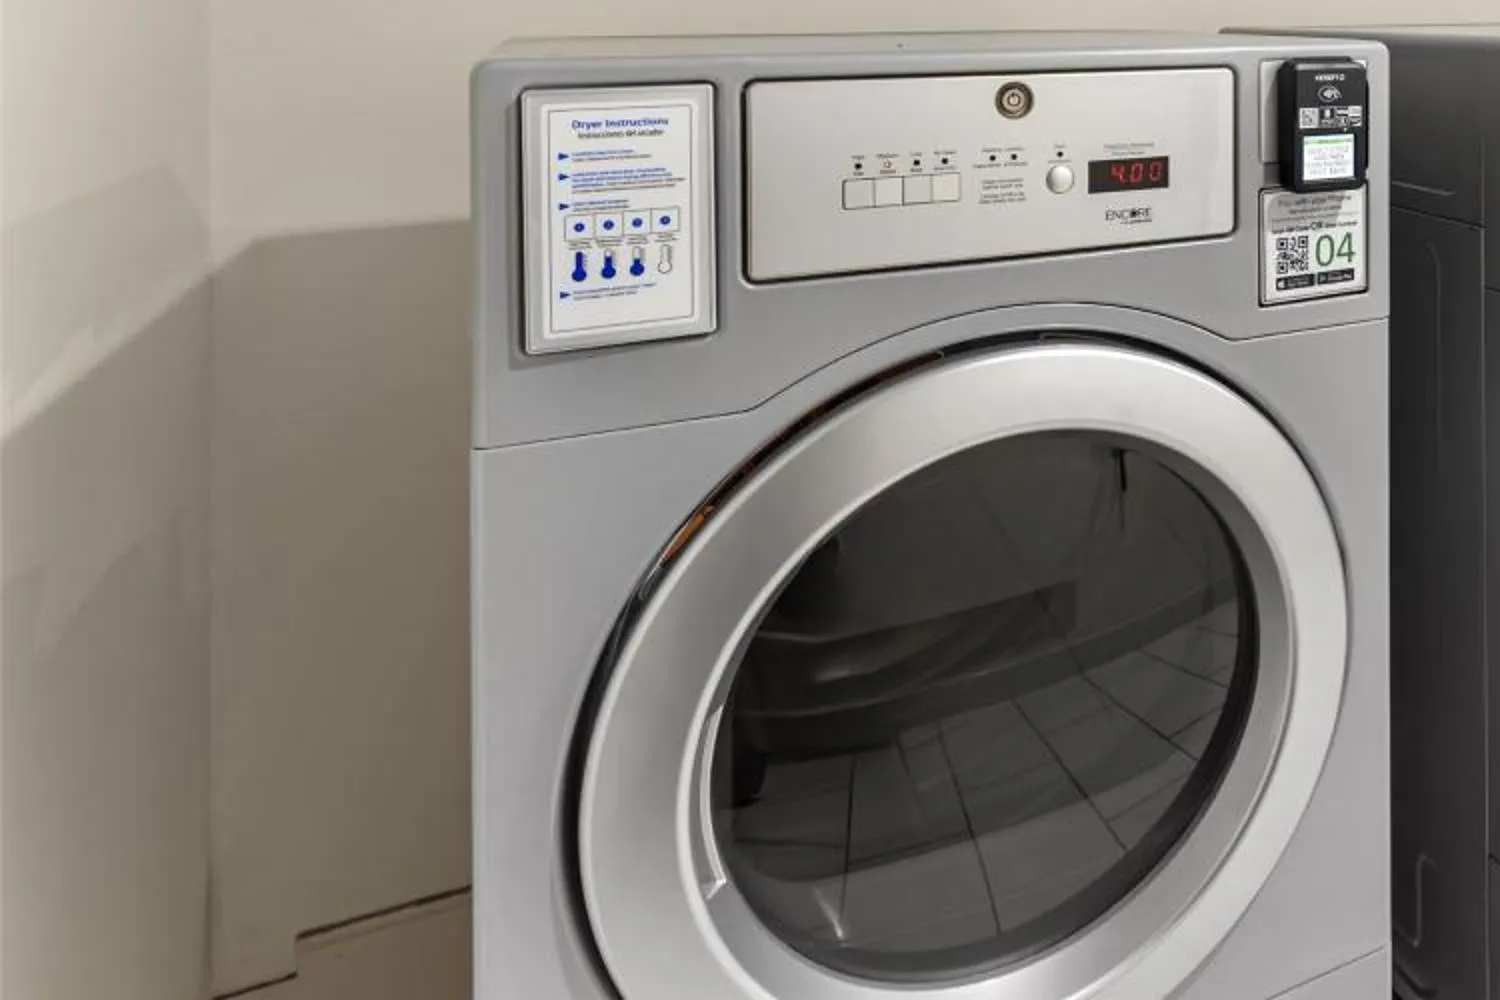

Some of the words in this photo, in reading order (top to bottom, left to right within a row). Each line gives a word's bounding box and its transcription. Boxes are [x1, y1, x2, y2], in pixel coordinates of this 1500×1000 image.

[571, 119, 602, 129] Dryer
[605, 117, 669, 126] Instructions
[1104, 207, 1153, 221] ENCORE
[1315, 231, 1356, 267] 04
